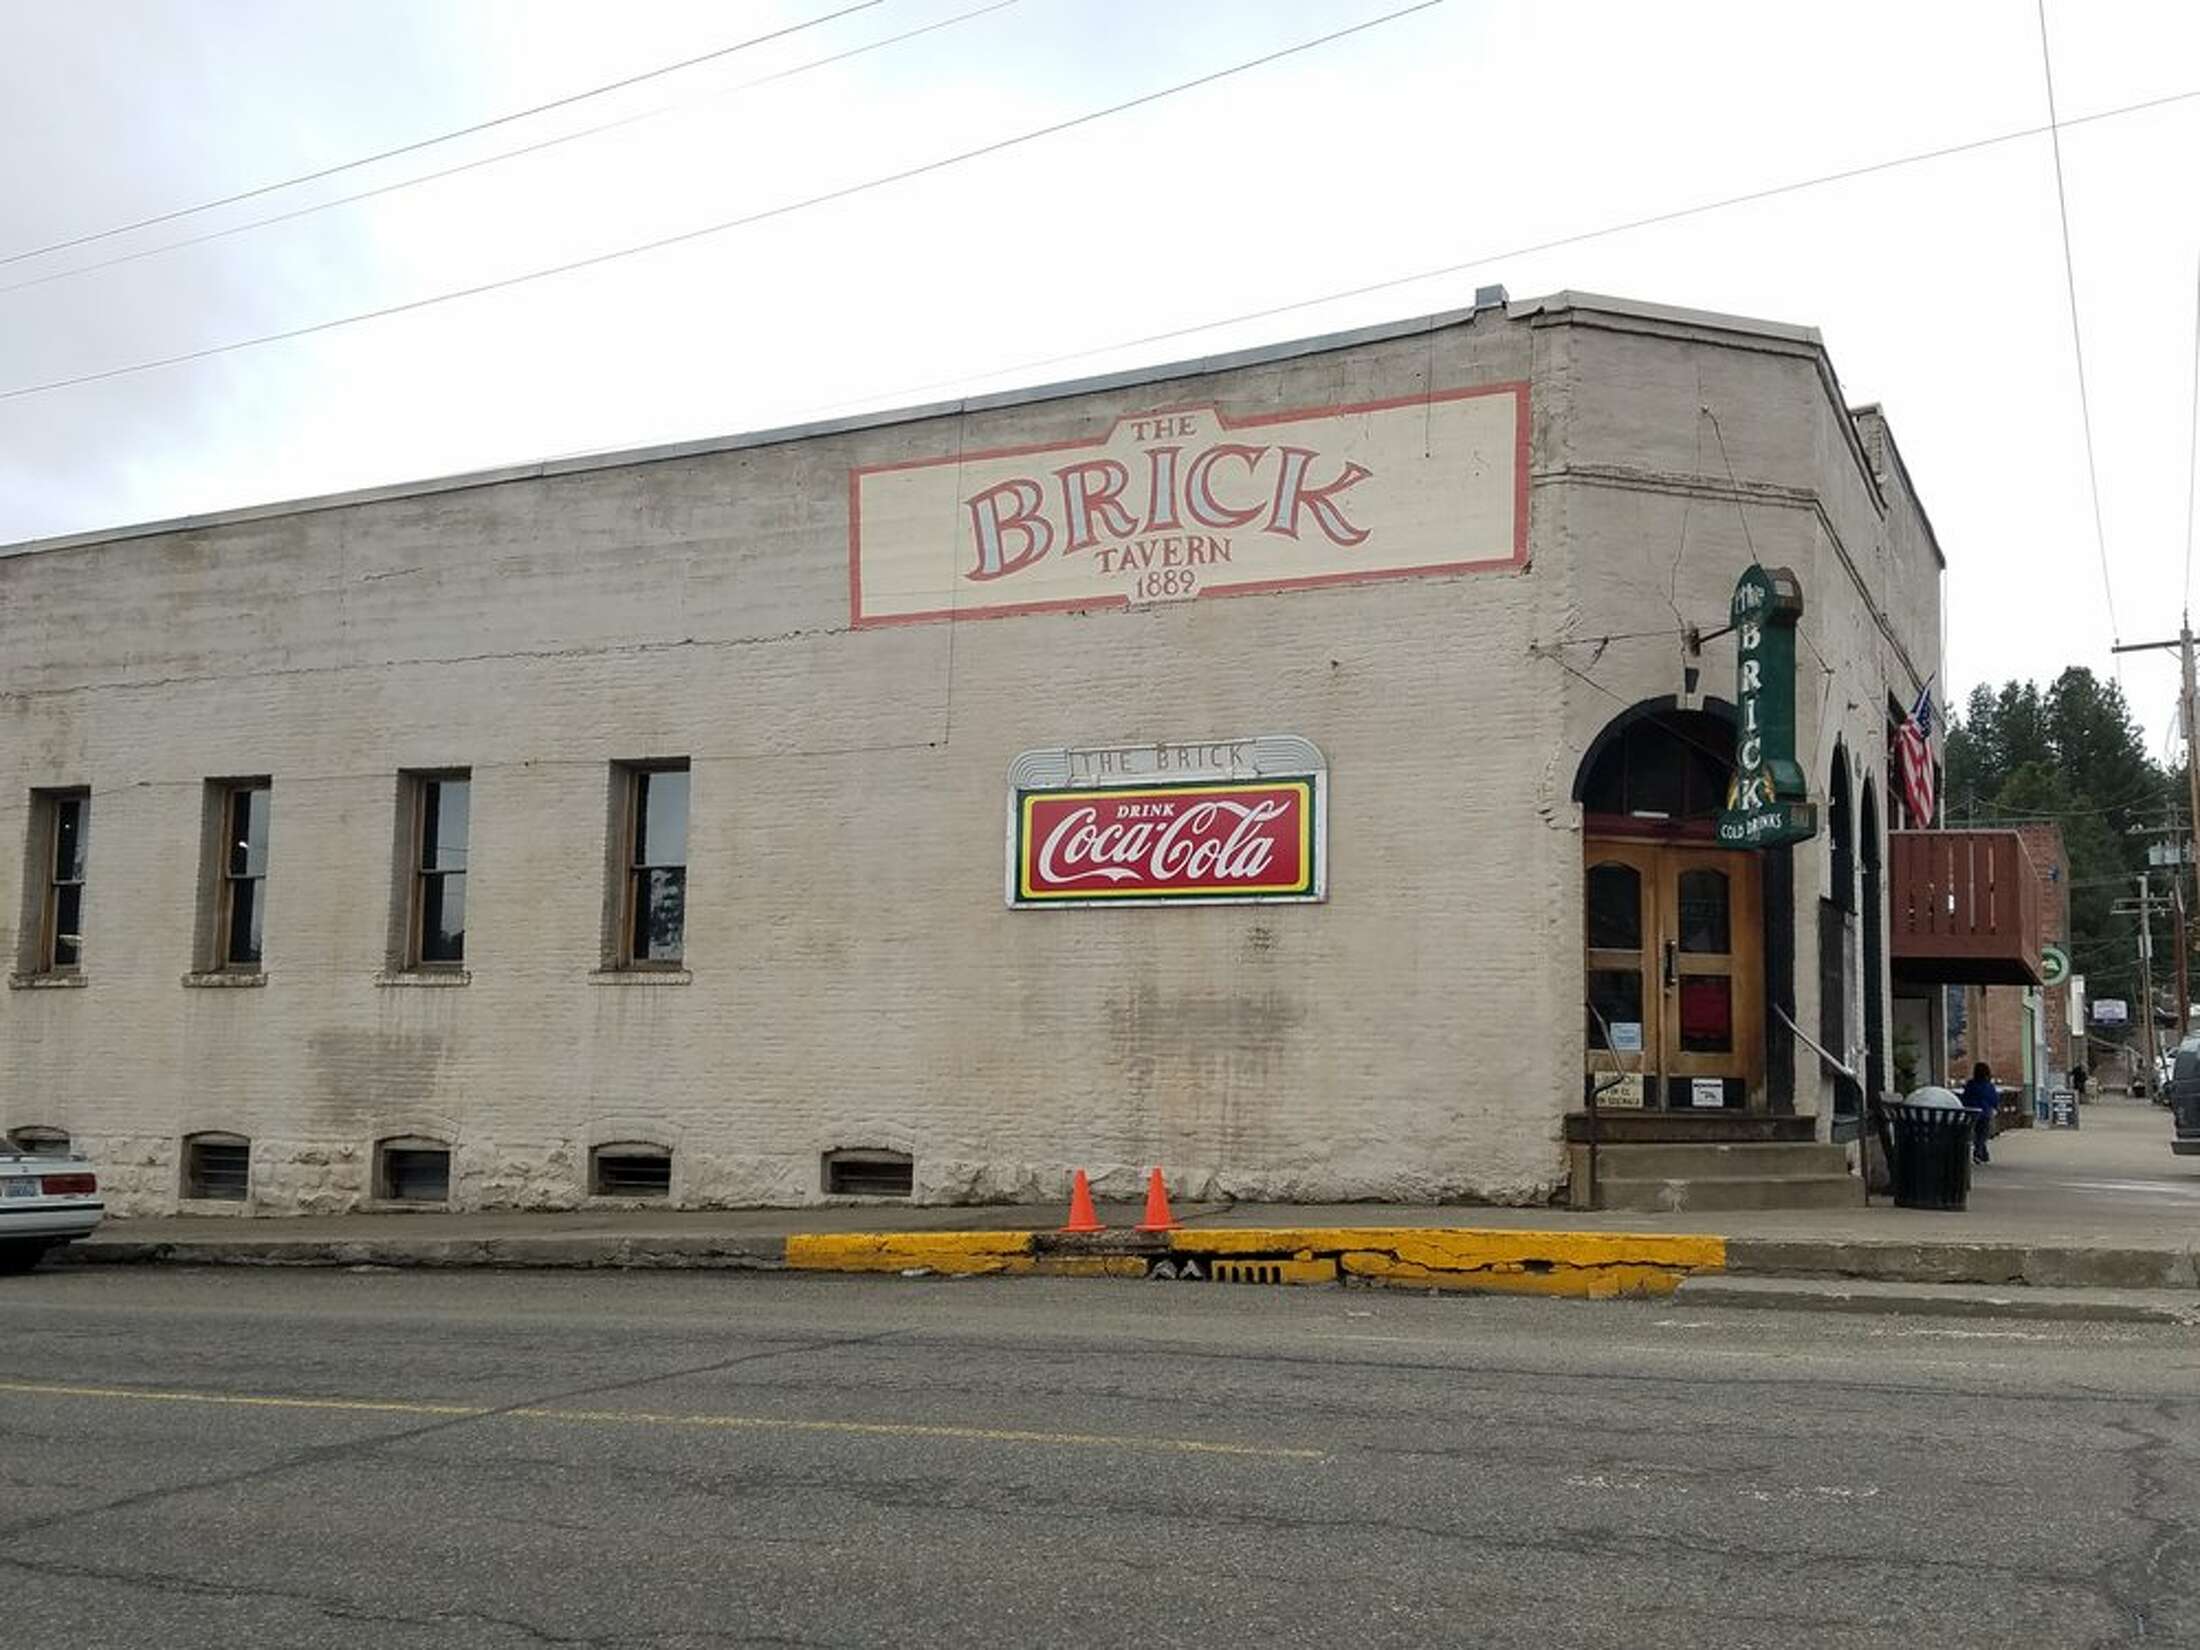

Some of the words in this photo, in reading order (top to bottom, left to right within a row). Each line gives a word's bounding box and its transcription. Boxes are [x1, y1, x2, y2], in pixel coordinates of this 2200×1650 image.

[1130, 418, 1198, 442] THE
[963, 443, 1374, 583] BRICK
[1094, 535, 1233, 574] TAVERN
[1135, 570, 1196, 597] 1889
[1741, 623, 1764, 811] BRICK
[1080, 749, 1137, 773] THE
[1156, 743, 1245, 770] BRICK
[1116, 802, 1175, 819] DRINK
[1038, 800, 1291, 883] Coca-Cola
[1720, 823, 1746, 840] COLD
